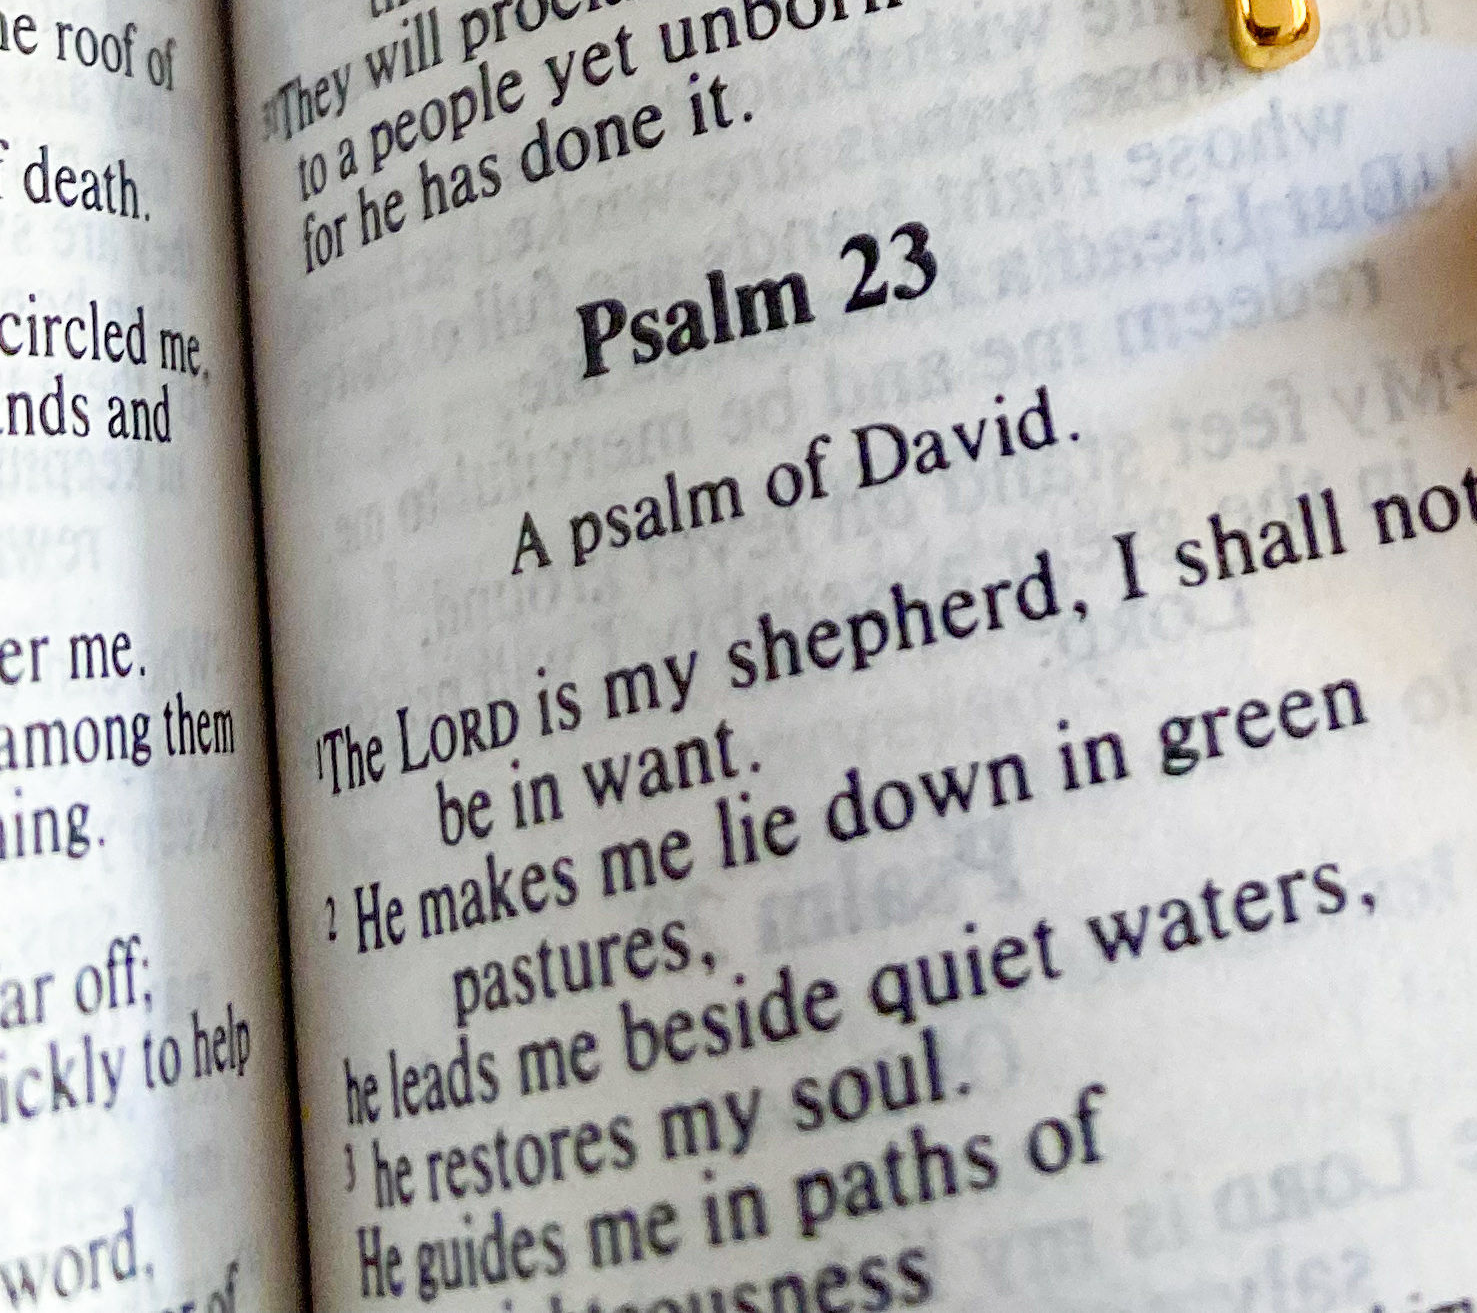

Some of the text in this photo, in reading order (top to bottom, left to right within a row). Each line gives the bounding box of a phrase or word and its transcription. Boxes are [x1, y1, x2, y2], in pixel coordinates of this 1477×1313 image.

[55, 21, 178, 92] roof of
[365, 7, 442, 88] will
[370, 25, 637, 174] people yet
[24, 144, 151, 222] death.
[358, 73, 752, 246] he has done it.
[576, 222, 937, 380] Psalm 23
[108, 383, 172, 444] and
[511, 385, 1079, 576] A psalm of David.
[70, 631, 146, 679] me.
[396, 699, 519, 774] LORD
[538, 666, 581, 736] is
[604, 650, 698, 719] my
[727, 549, 1087, 689] shepherd,
[1113, 531, 1146, 601] I
[1175, 488, 1347, 587] shall
[164, 690, 236, 758] them
[436, 720, 760, 846] be in want.
[354, 679, 1368, 953] He makes me lie down in green
[344, 864, 1375, 1124] he leads me beside quiet waters,
[453, 921, 744, 1028] pastures,
[142, 1000, 251, 1090] to help
[373, 1028, 970, 1208] he restores my soul.
[358, 1083, 1106, 1303] He guides me in paths of
